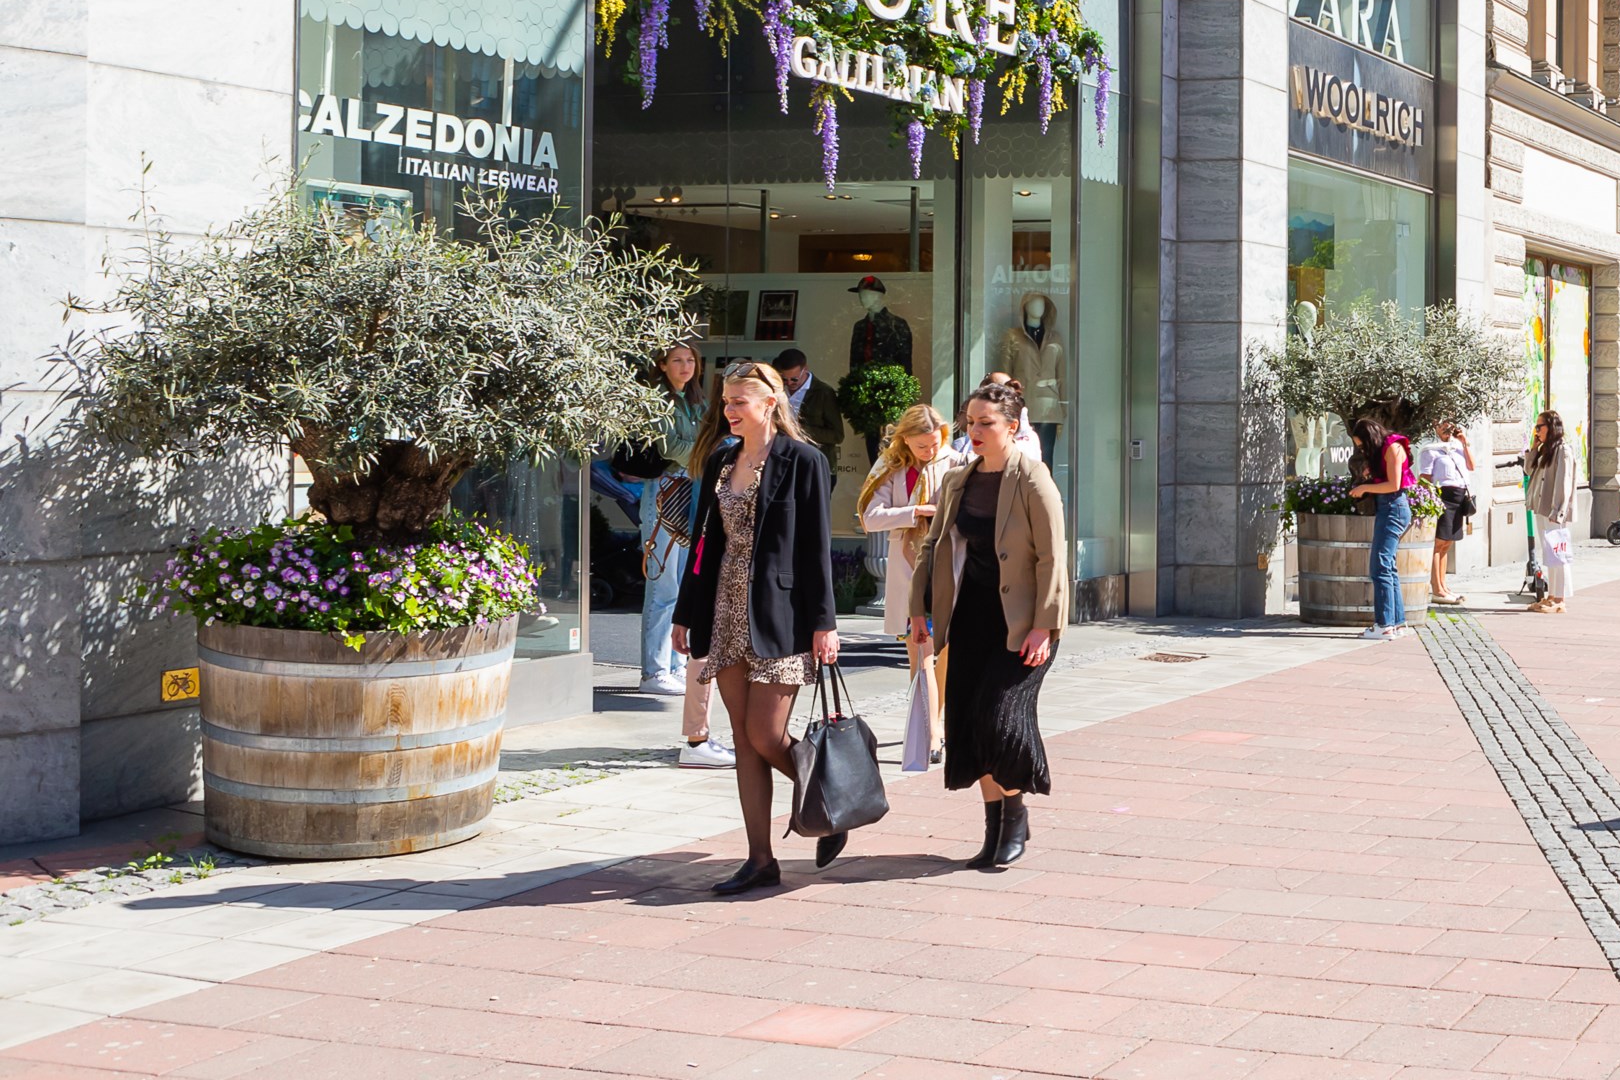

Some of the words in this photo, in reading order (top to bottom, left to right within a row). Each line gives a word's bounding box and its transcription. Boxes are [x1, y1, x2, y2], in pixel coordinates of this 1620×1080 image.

[1304, 65, 1424, 147] WOOLRICH
[405, 157, 475, 183] ITALIAN
[479, 167, 559, 194] LEGWEAR
[837, 465, 857, 473] RICH
